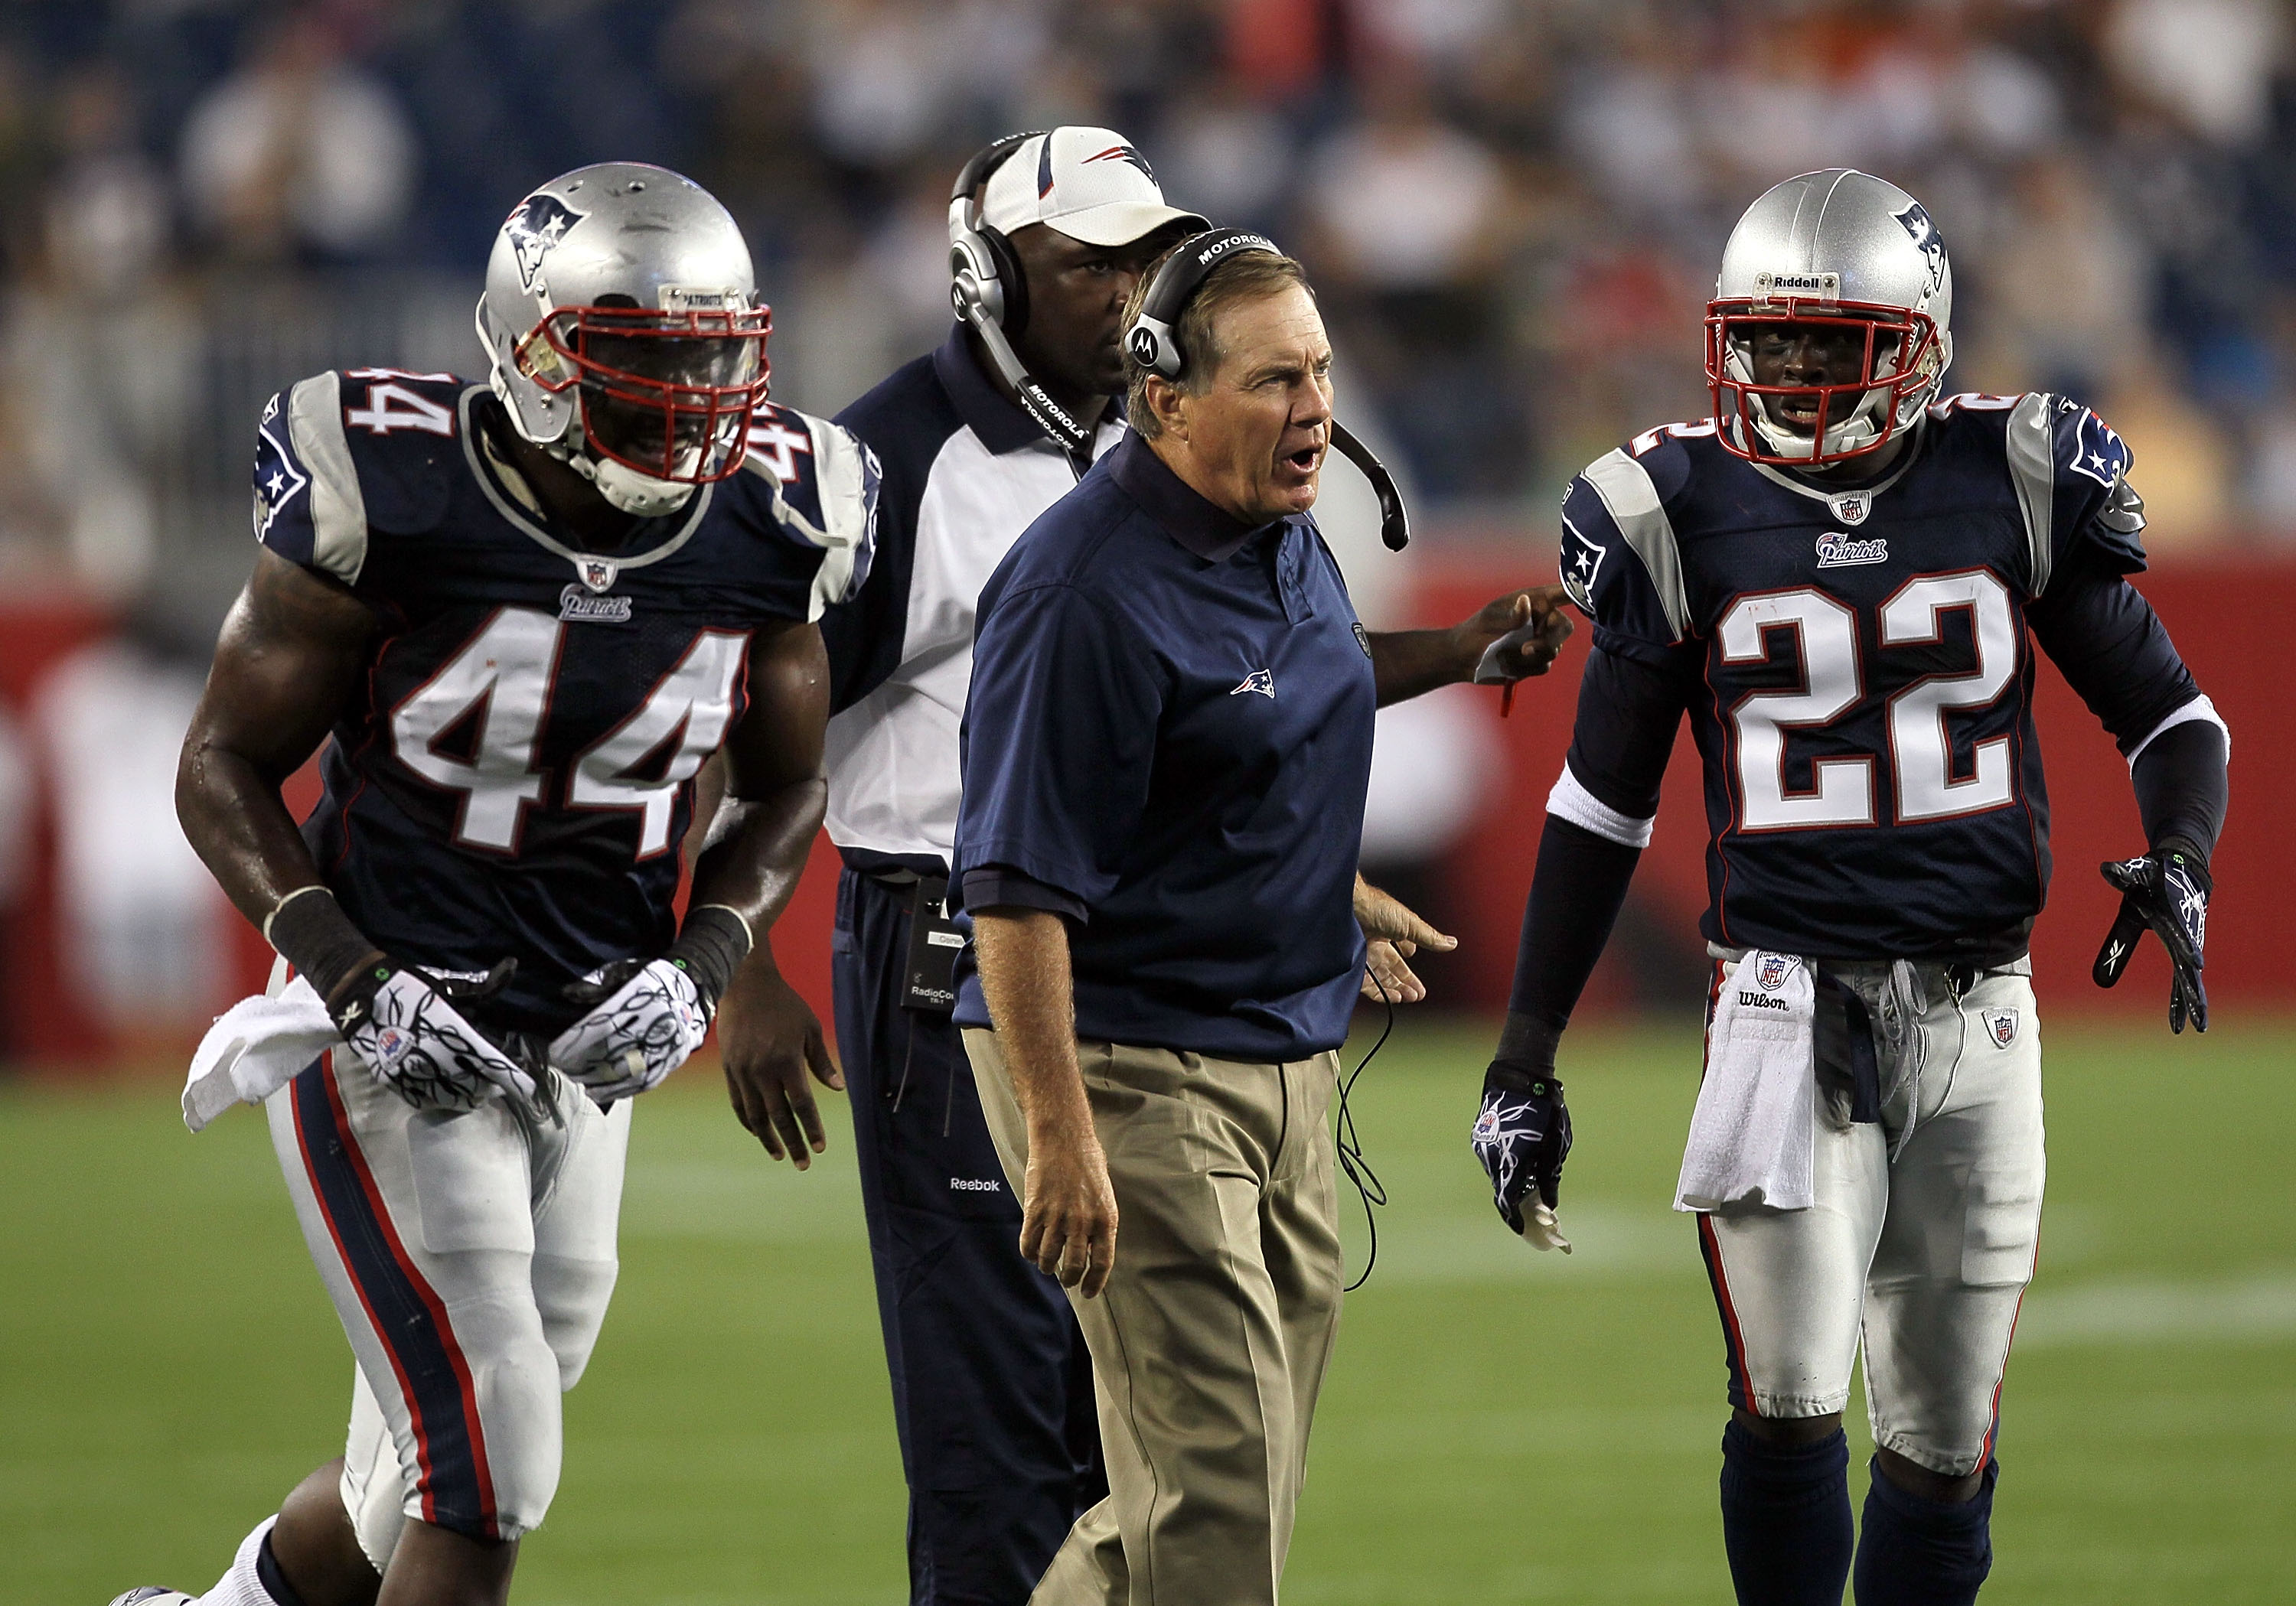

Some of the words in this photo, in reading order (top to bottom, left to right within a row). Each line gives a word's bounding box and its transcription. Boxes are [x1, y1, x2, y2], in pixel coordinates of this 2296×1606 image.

[1775, 276, 1819, 288] Riddell
[1028, 384, 1085, 439] MOTOROLA
[1842, 508, 1861, 520] NFL
[1818, 537, 1888, 568] Patriots
[559, 591, 632, 621] Patriots
[1716, 564, 2017, 835] 22
[390, 603, 753, 862] 44
[1761, 969, 1780, 985] NFL
[1739, 991, 1786, 1011] Wilson
[1998, 1028, 2013, 1041] NFL
[951, 1178, 1000, 1191] Reebok
